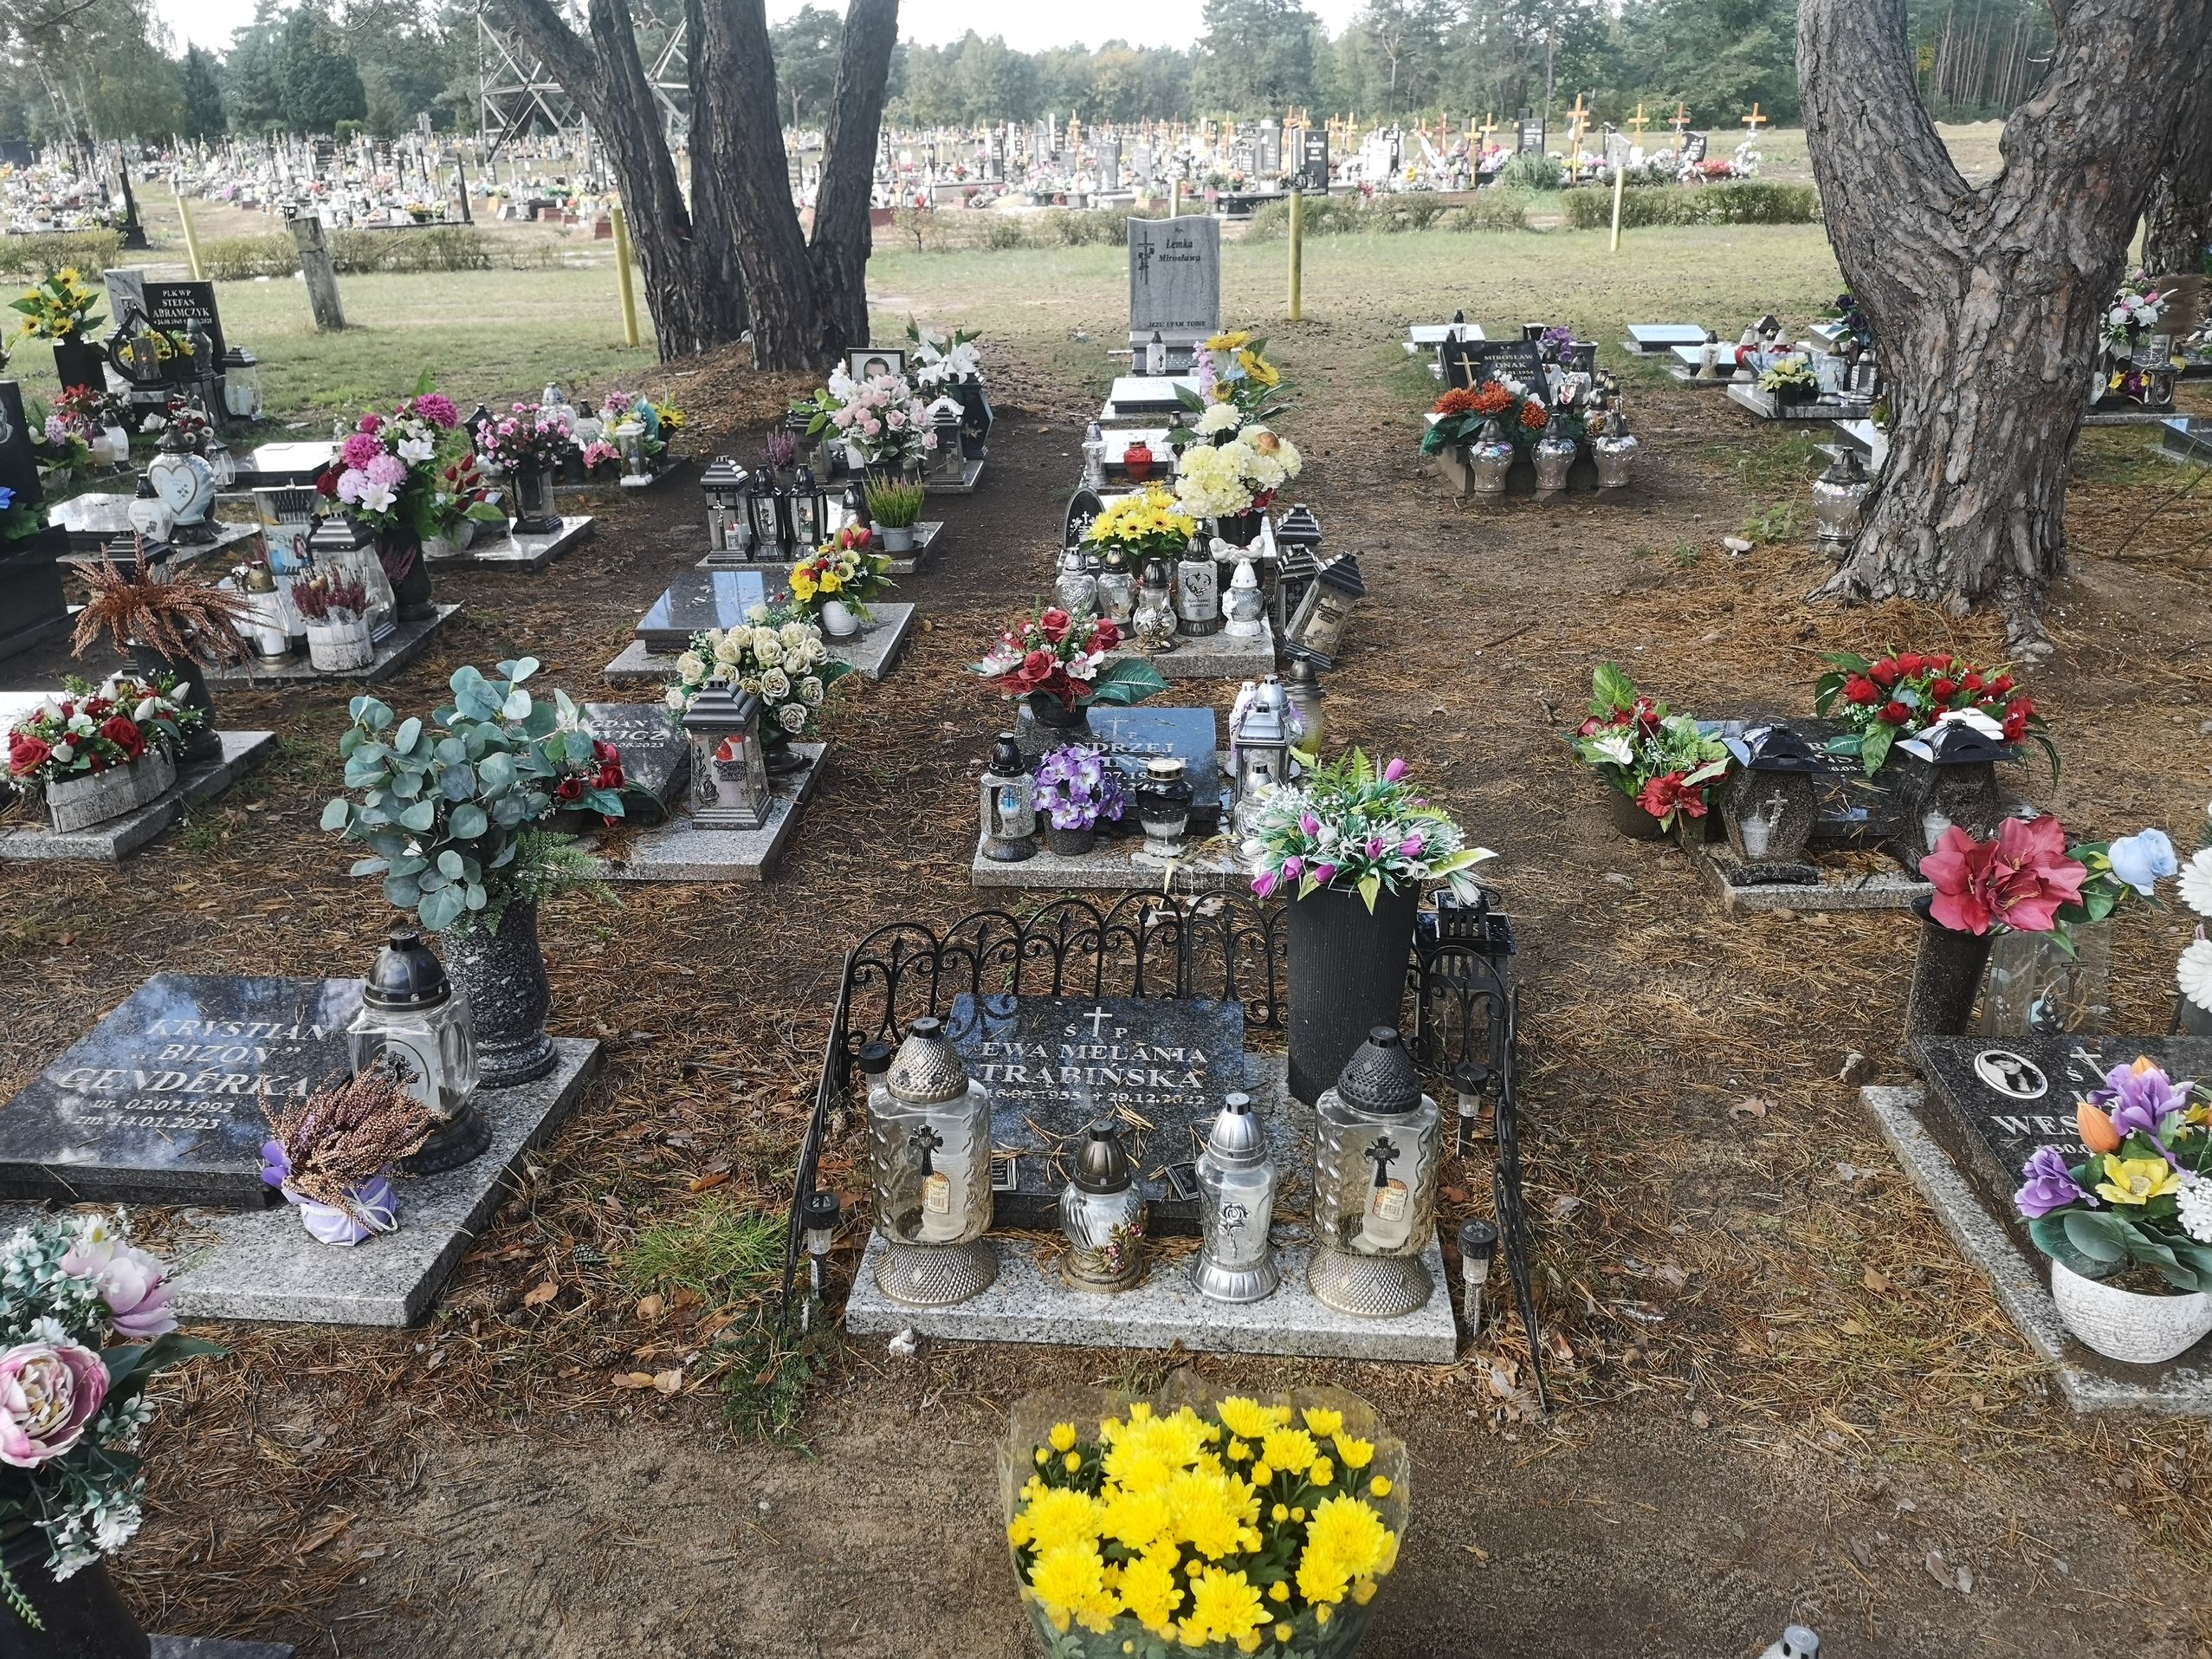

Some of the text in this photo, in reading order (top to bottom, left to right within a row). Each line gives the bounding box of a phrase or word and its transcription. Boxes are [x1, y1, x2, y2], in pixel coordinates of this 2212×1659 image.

[162, 298, 196, 308] STEFAN
[152, 308, 210, 318] ABRAMCZYK
[145, 1019, 332, 1040] KRYSTIAN
[1064, 1023, 1128, 1038] Ś P
[980, 1042, 1208, 1063] EWA MELANIA
[978, 1063, 1204, 1089] TRĄBIŃSKA
[92, 1098, 236, 1114] ur. 02.07.1992
